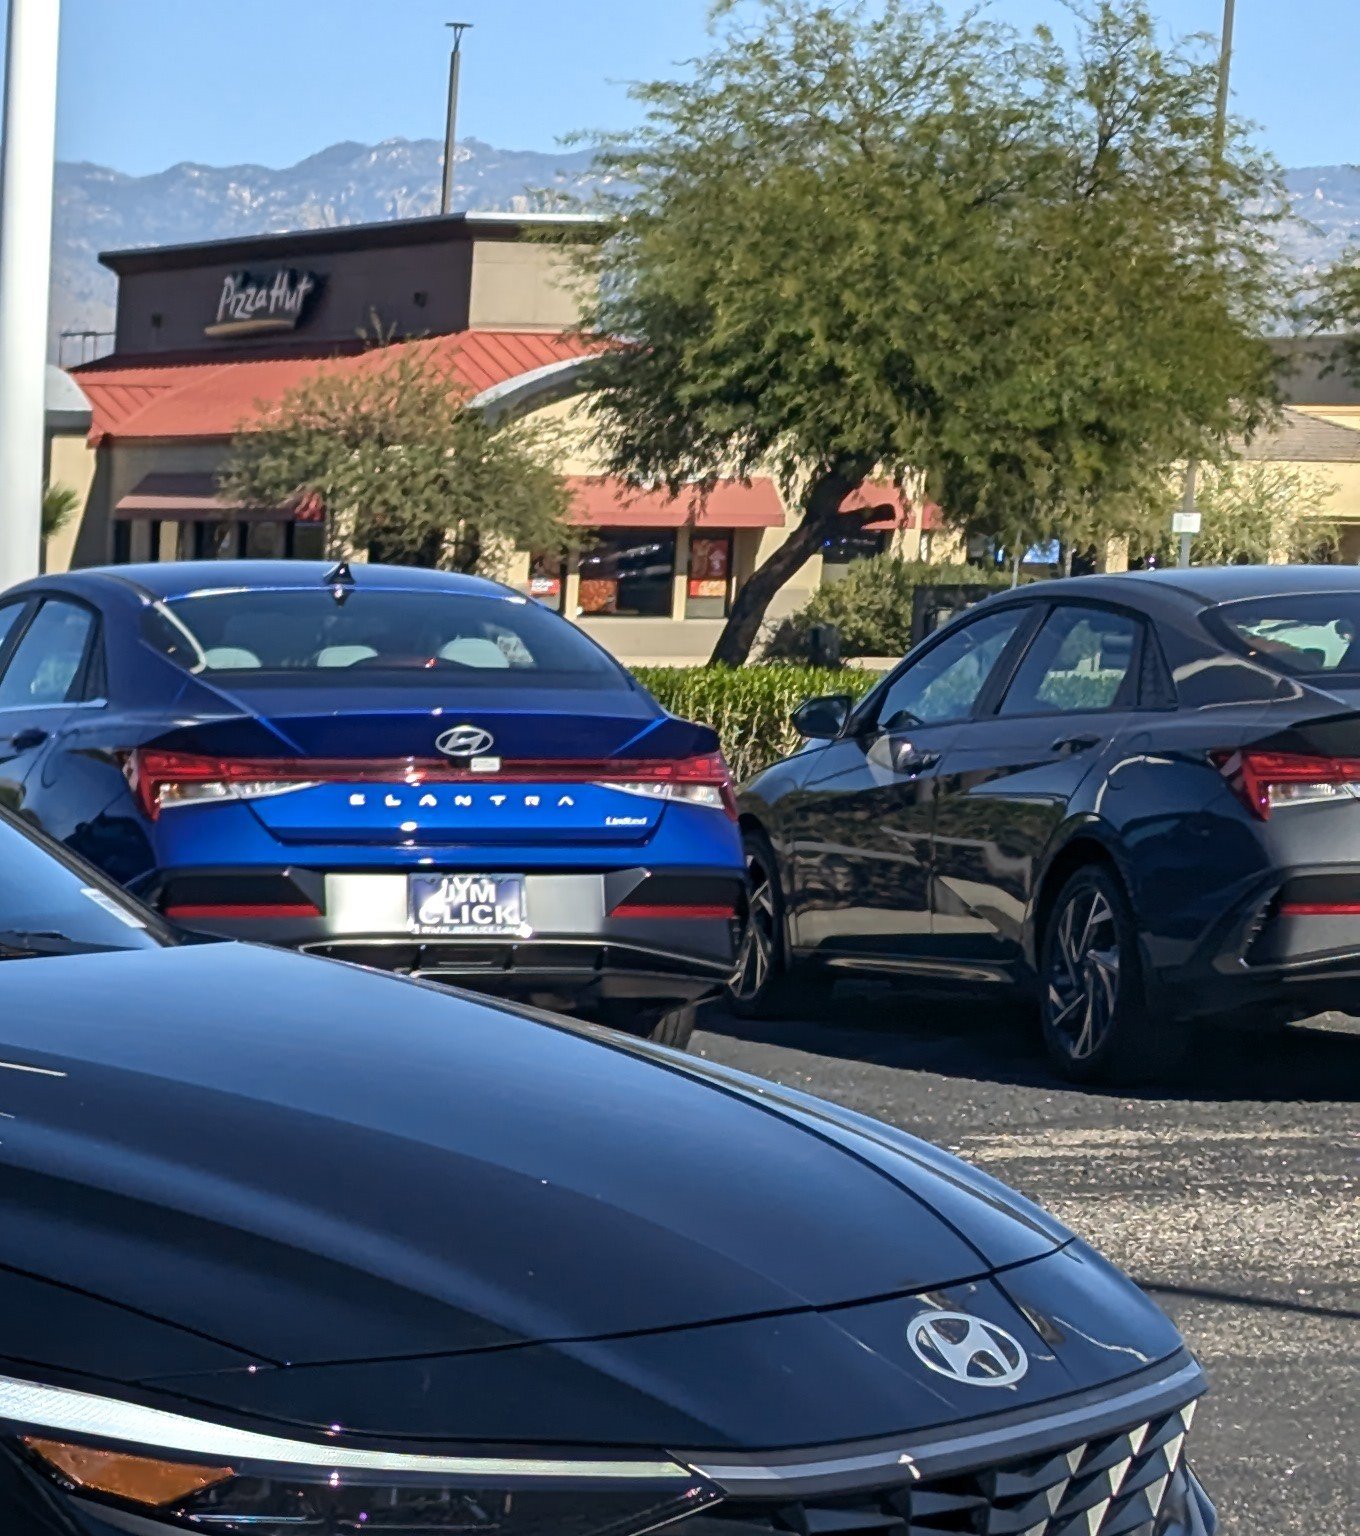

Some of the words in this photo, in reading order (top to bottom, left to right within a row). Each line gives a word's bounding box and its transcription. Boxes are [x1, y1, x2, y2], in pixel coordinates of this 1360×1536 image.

[216, 273, 268, 322] Pizza
[269, 271, 313, 314] Hut
[349, 794, 574, 807] ELANTRA
[418, 903, 521, 925] CLICK
